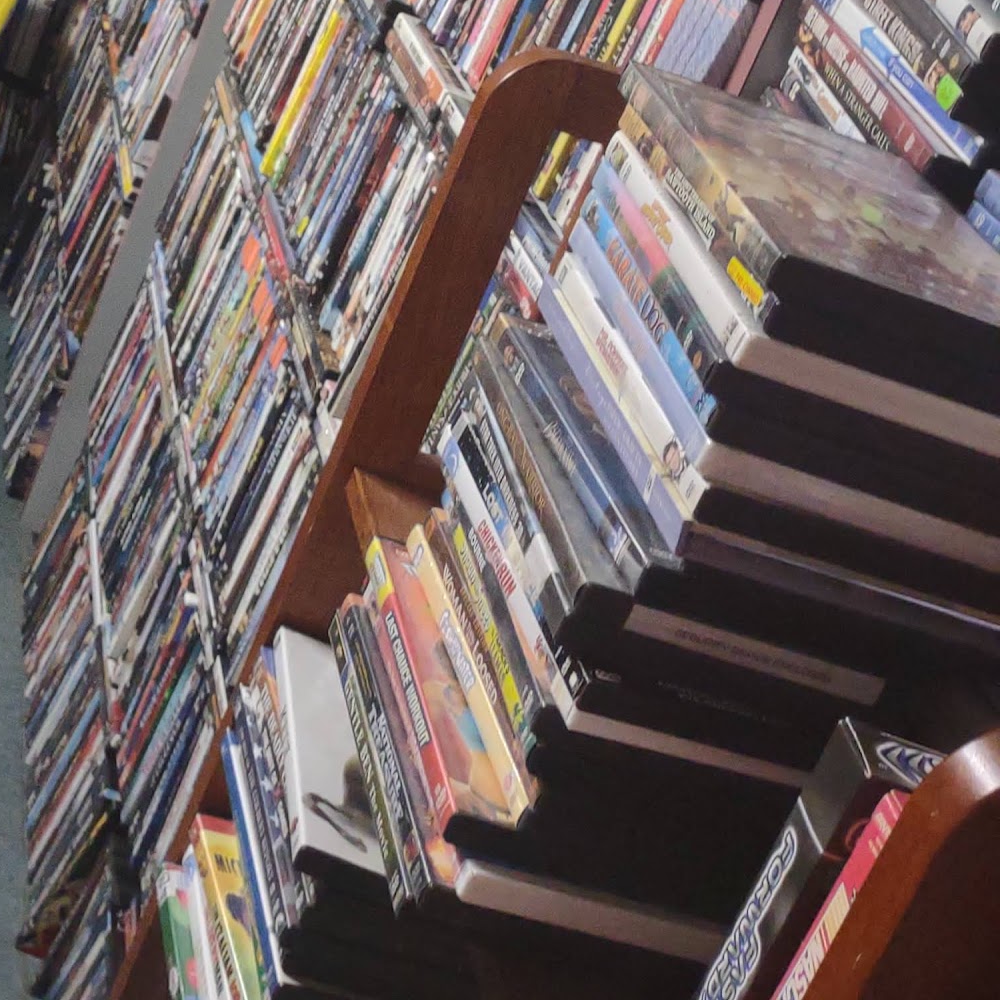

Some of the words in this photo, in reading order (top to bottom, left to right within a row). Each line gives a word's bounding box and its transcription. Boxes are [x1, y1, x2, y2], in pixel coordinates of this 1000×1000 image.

[886, 15, 922, 64] KINGS
[823, 63, 842, 90] WHEN
[834, 82, 848, 96] A
[842, 90, 875, 133] STRANGER
[868, 124, 889, 152] CALLS
[691, 205, 716, 241] ISLAND
[604, 237, 645, 306] KARATE
[637, 293, 668, 345] DOG
[479, 482, 504, 524] LOST
[466, 527, 487, 572] BOURNE
[476, 518, 507, 571] CHICKEN
[494, 564, 518, 599] RUN
[383, 611, 398, 643] LAST
[391, 639, 411, 690] CHANCE
[403, 685, 430, 746] WORKOUT
[440, 563, 468, 629] WOMAN
[470, 639, 497, 705] LOOSED
[366, 702, 404, 821] TREASURE
[375, 711, 404, 798] NATIONAL
[357, 746, 372, 784] BEN
[372, 812, 389, 858] Movie
[700, 826, 805, 999] FORWARD
